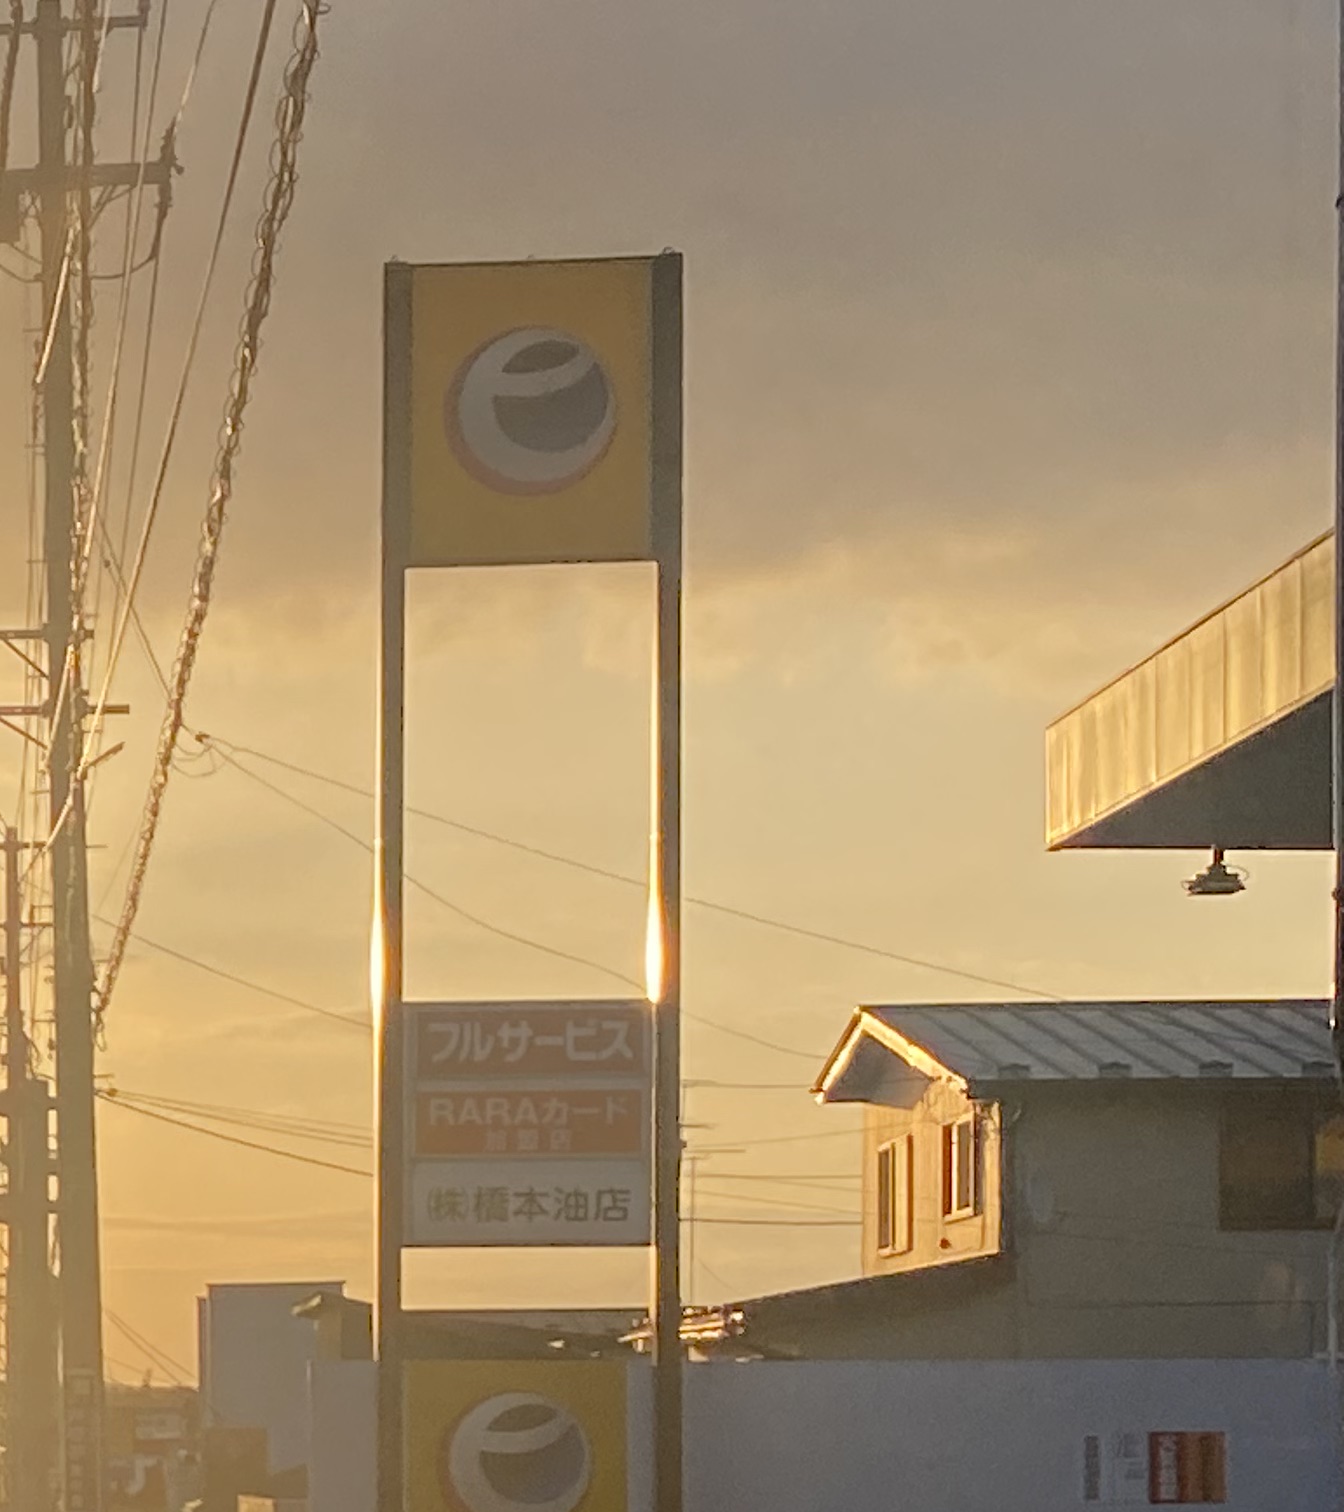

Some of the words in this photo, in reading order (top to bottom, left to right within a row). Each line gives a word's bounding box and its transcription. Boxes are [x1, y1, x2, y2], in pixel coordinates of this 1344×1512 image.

[427, 1019, 635, 1063] フルサービス
[429, 1096, 629, 1126] RARAカード
